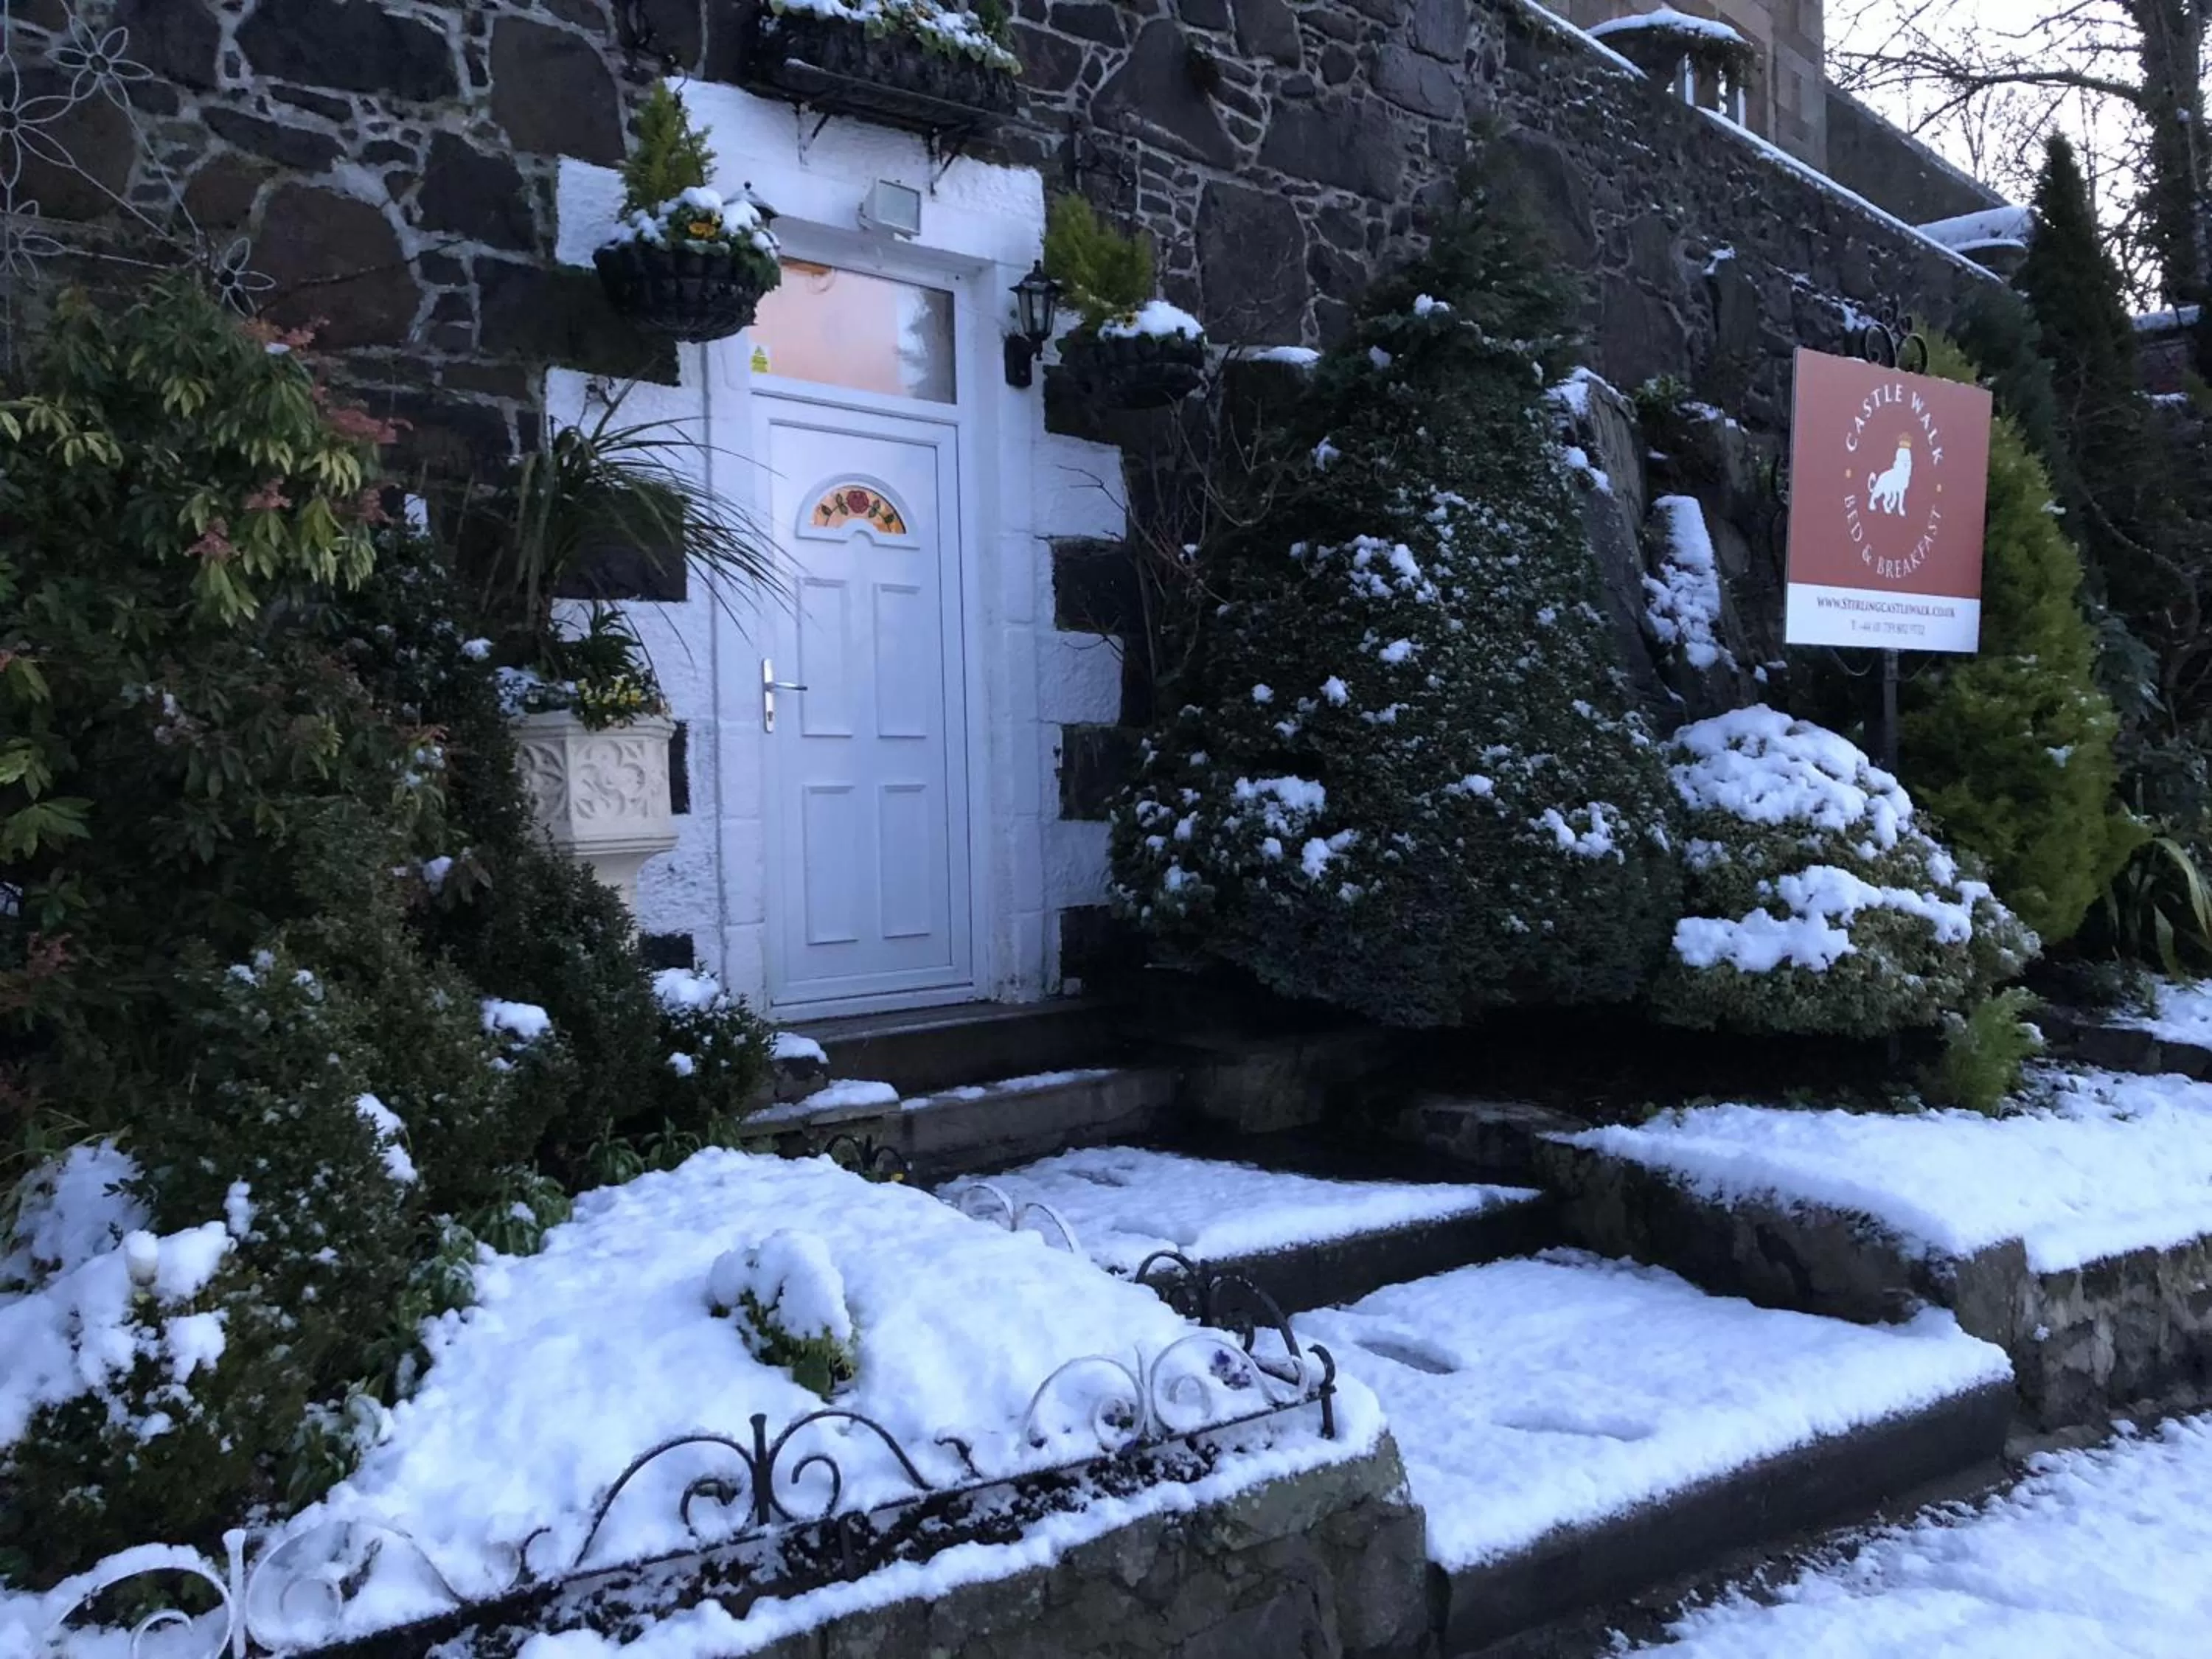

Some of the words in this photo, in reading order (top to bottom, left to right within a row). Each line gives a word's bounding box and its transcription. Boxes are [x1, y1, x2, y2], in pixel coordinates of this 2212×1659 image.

[1846, 383, 1903, 452] CASTLE
[1911, 391, 1944, 465] WALK
[1844, 495, 1863, 542] BED
[1862, 543, 1872, 566] &
[1877, 504, 1941, 578] BREAKFAST
